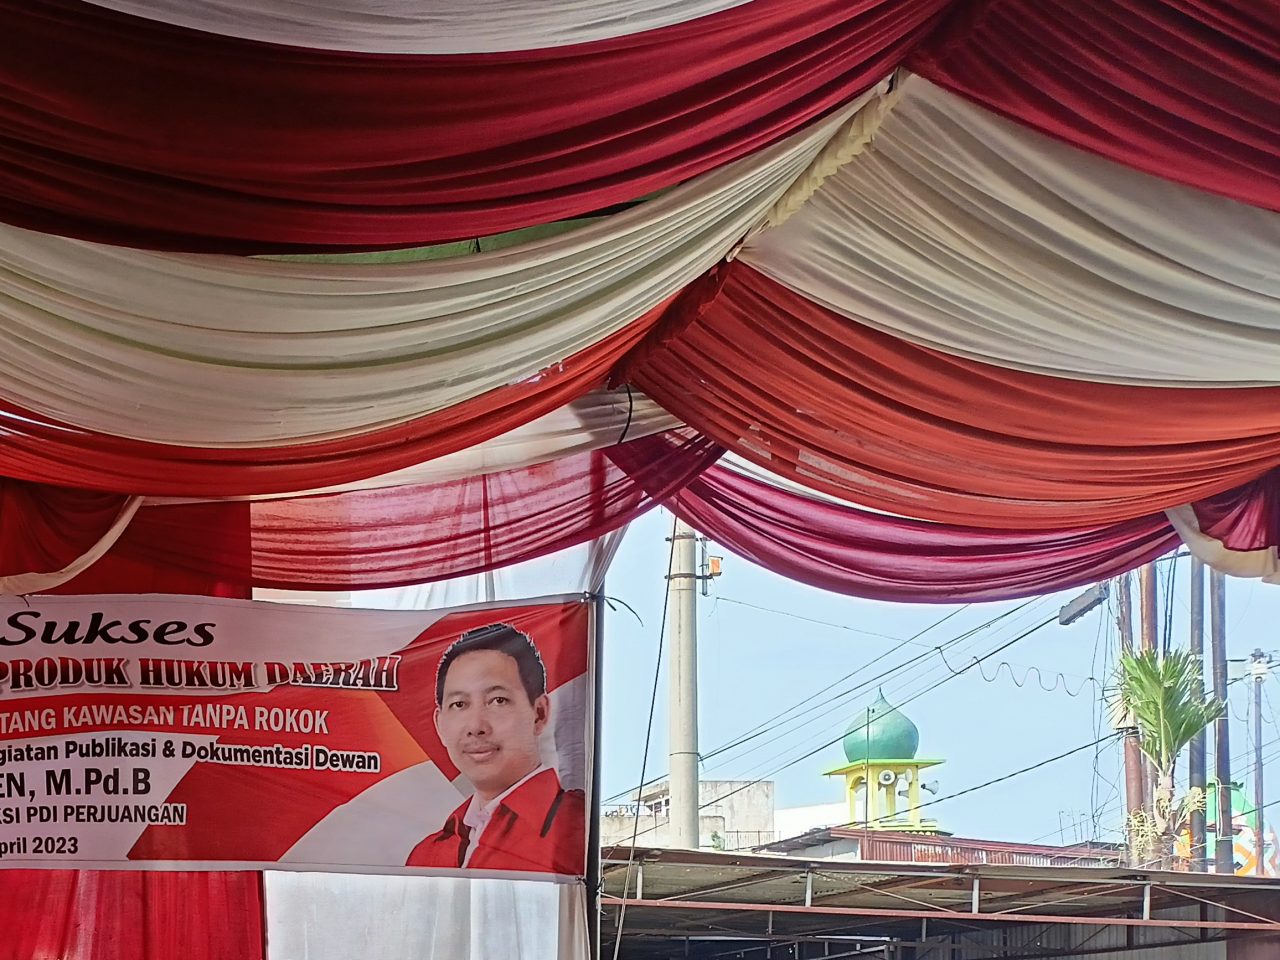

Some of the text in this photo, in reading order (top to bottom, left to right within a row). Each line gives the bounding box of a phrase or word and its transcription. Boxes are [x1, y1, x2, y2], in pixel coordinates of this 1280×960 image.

[138, 656, 257, 689] HUKUM
[264, 654, 402, 691] DAERAH
[63, 703, 175, 728] KAWASAN
[179, 703, 250, 730] TANPA
[254, 706, 329, 734] ROKOK
[64, 737, 157, 760] Publikasi
[163, 740, 176, 759] &
[181, 740, 309, 767] Dokumentasi
[314, 749, 381, 773] Dewan
[45, 766, 152, 797] M.Pd.B
[25, 804, 58, 824] PDI
[62, 803, 187, 826] PERJUANGAN
[32, 836, 79, 856] 2023
